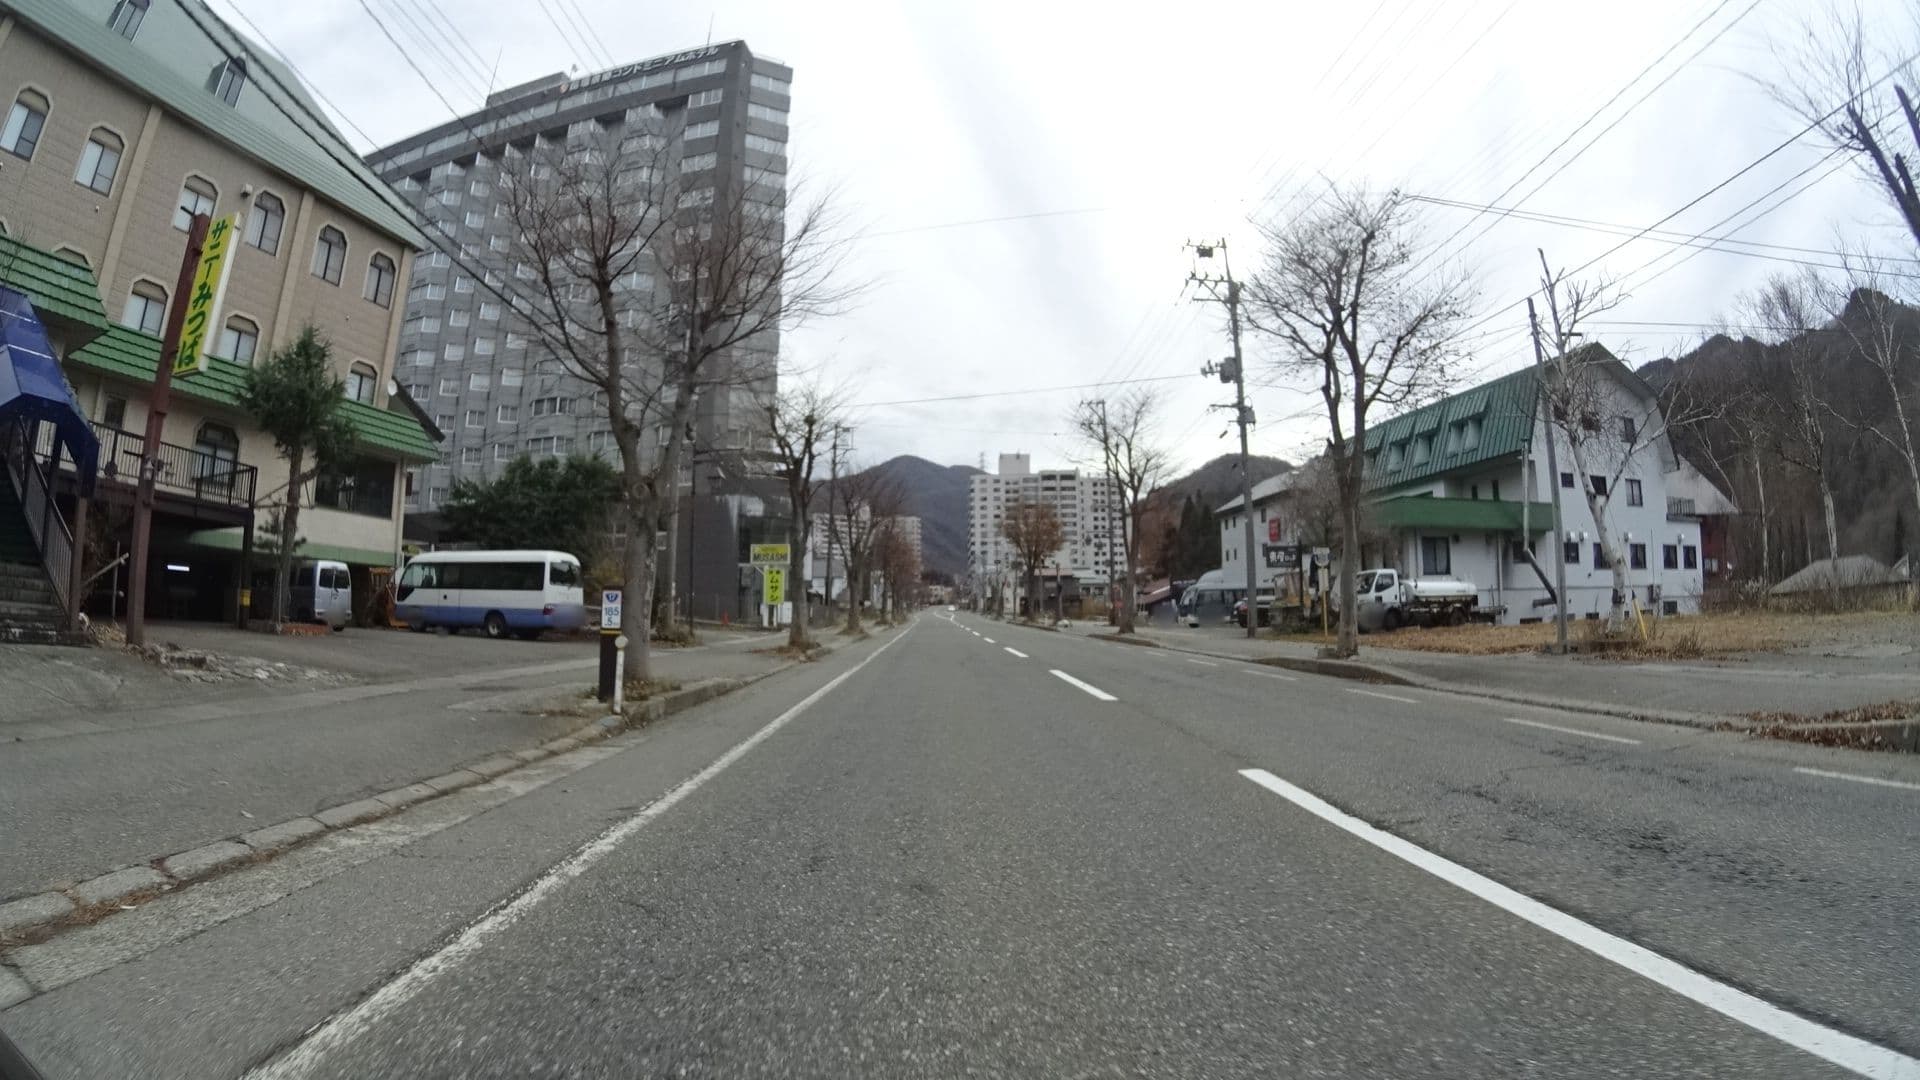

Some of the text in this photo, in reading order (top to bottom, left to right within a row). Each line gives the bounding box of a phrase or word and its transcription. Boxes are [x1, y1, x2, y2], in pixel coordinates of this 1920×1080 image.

[177, 218, 228, 369] サニーみつば
[753, 552, 788, 562] MUSASHI
[769, 576, 779, 602] ムサシ
[604, 607, 619, 616] 185
